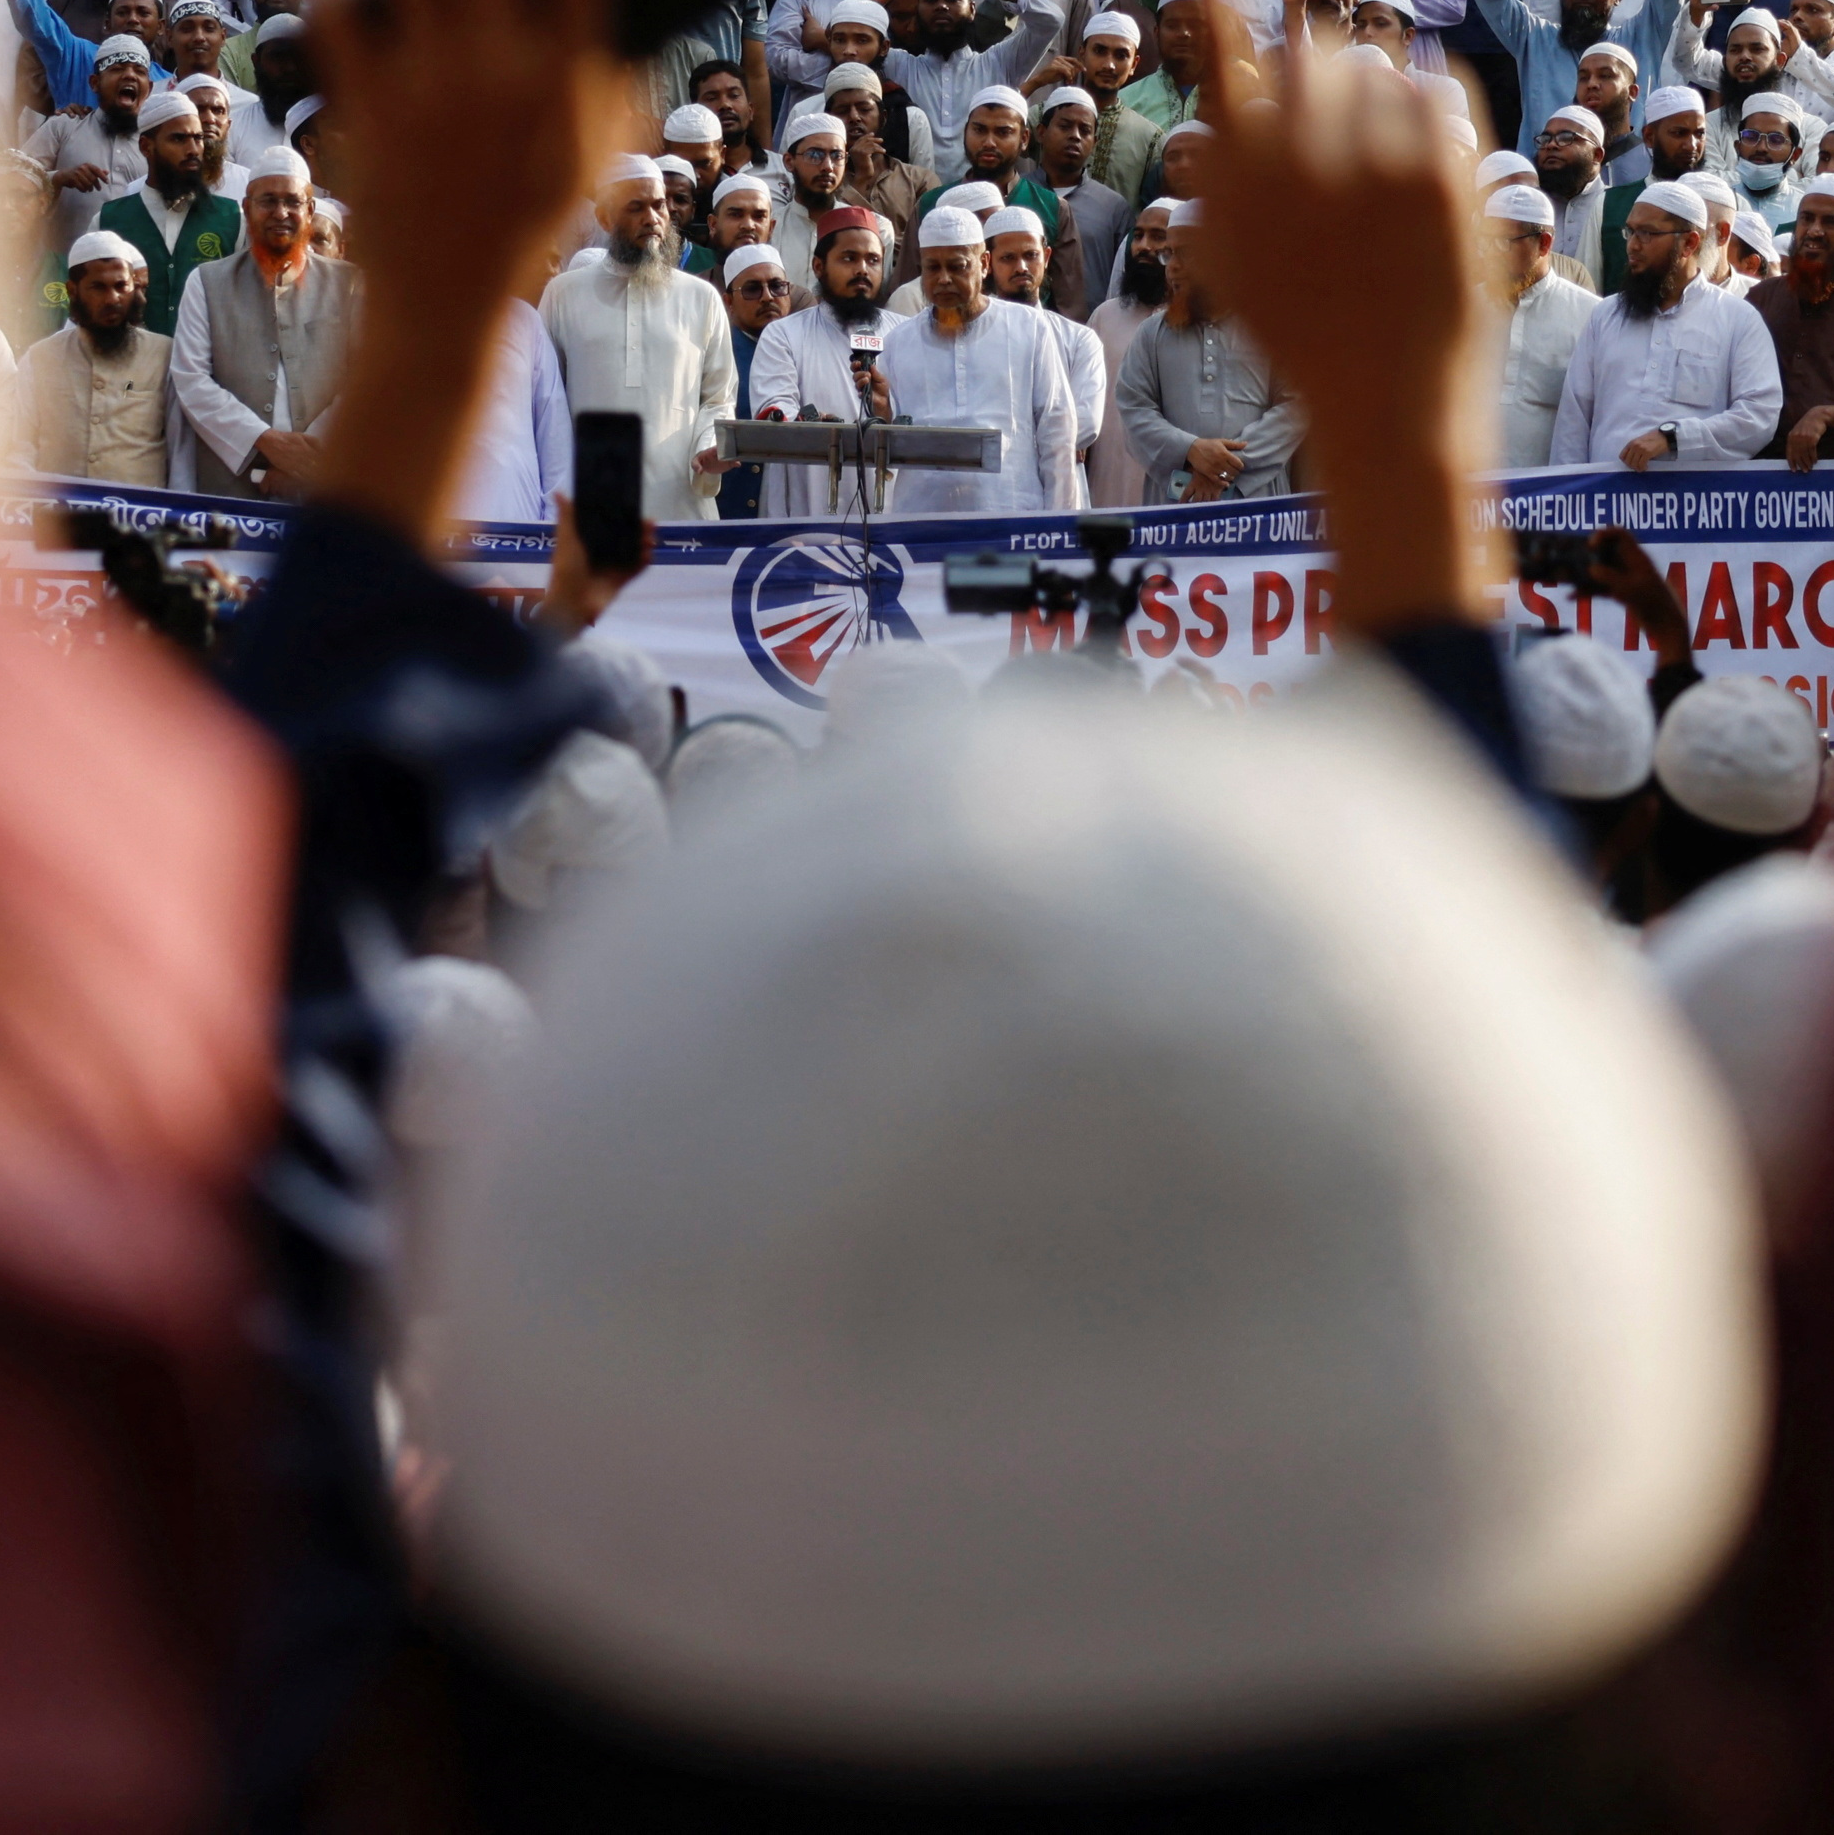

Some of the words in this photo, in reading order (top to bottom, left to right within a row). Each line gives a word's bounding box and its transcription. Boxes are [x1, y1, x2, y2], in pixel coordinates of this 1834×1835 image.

[1010, 531, 1082, 551] PEOPL
[1185, 514, 1264, 545] ACCEPT
[1268, 508, 1328, 542] UNILA
[1501, 492, 1607, 532] SCHEDULE
[1612, 492, 1679, 530] UNDER
[1683, 491, 1749, 529] PARTY
[1008, 573, 1230, 659] MSS
